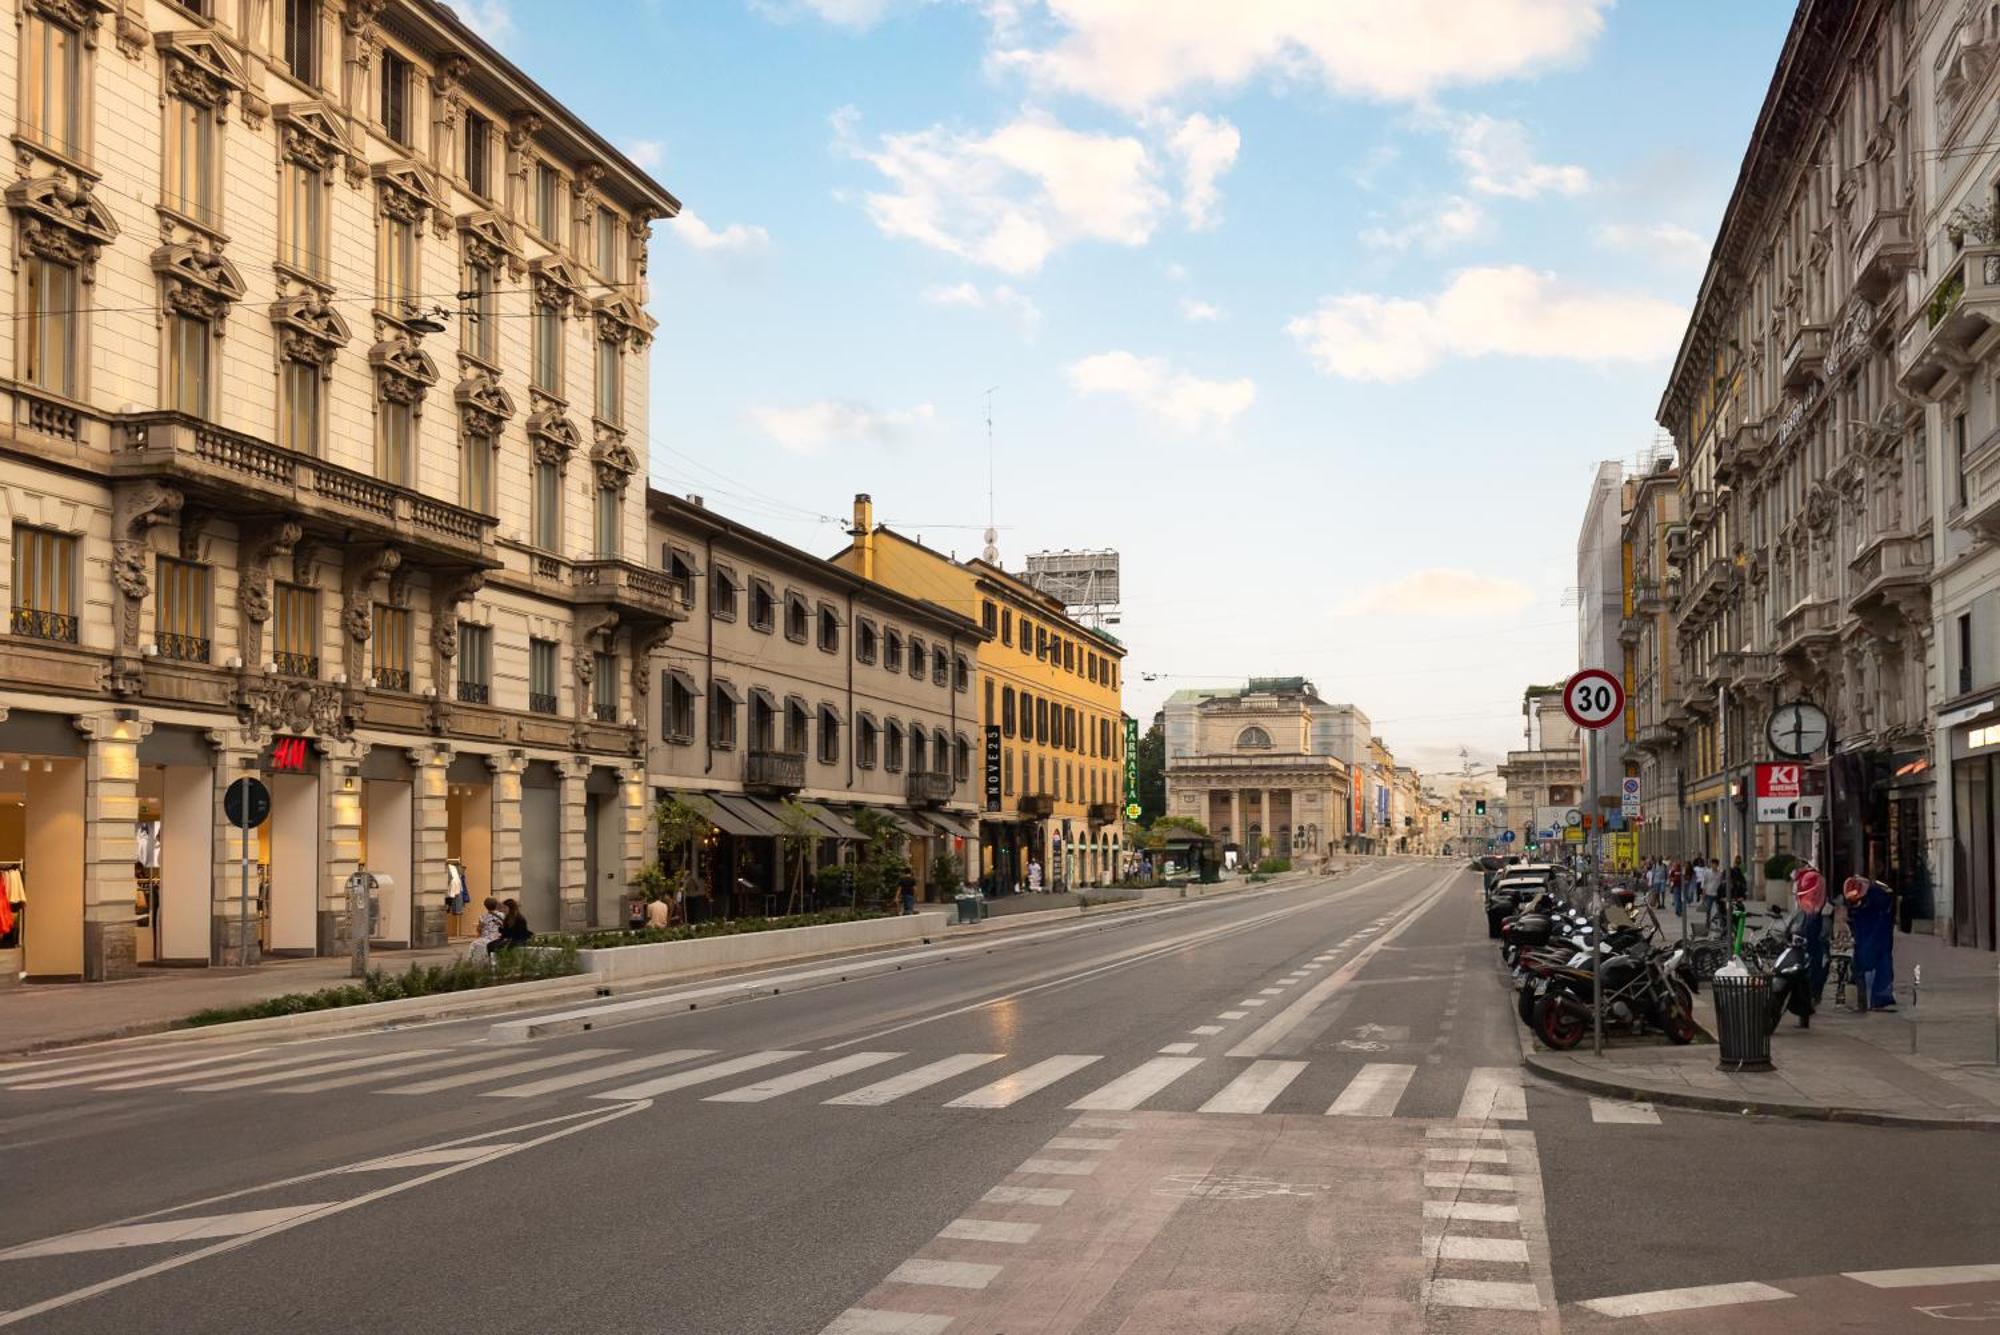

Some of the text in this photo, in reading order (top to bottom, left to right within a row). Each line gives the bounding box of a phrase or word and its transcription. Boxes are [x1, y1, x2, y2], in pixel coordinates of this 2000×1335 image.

[1578, 685, 1610, 713] 30
[988, 731, 999, 795] NOVE25
[1127, 723, 1137, 799] FARMACIA
